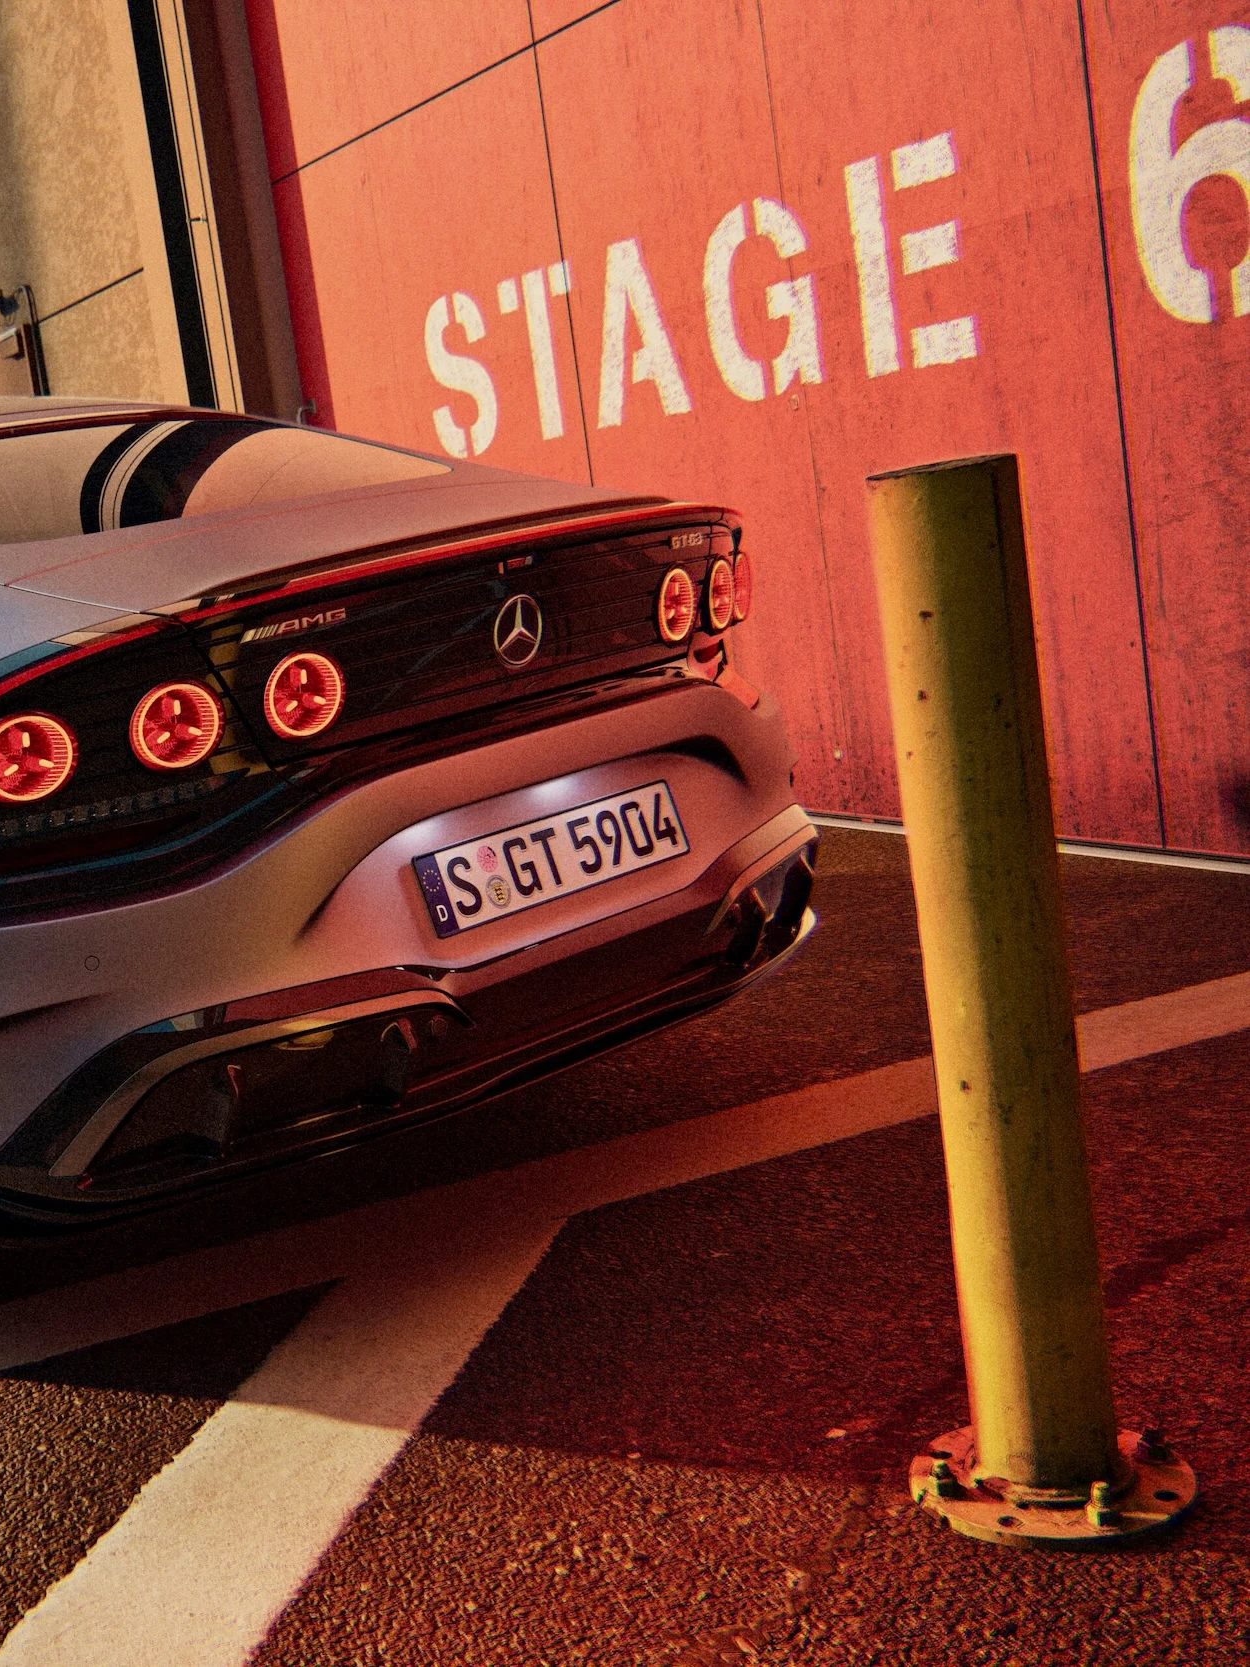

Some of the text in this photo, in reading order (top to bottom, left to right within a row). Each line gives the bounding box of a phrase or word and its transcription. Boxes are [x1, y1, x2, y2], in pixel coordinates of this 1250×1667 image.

[424, 25, 1250, 458] STAGE 6
[277, 608, 346, 634] AMG
[446, 793, 678, 917] S GT 5904
[436, 904, 449, 922] D
